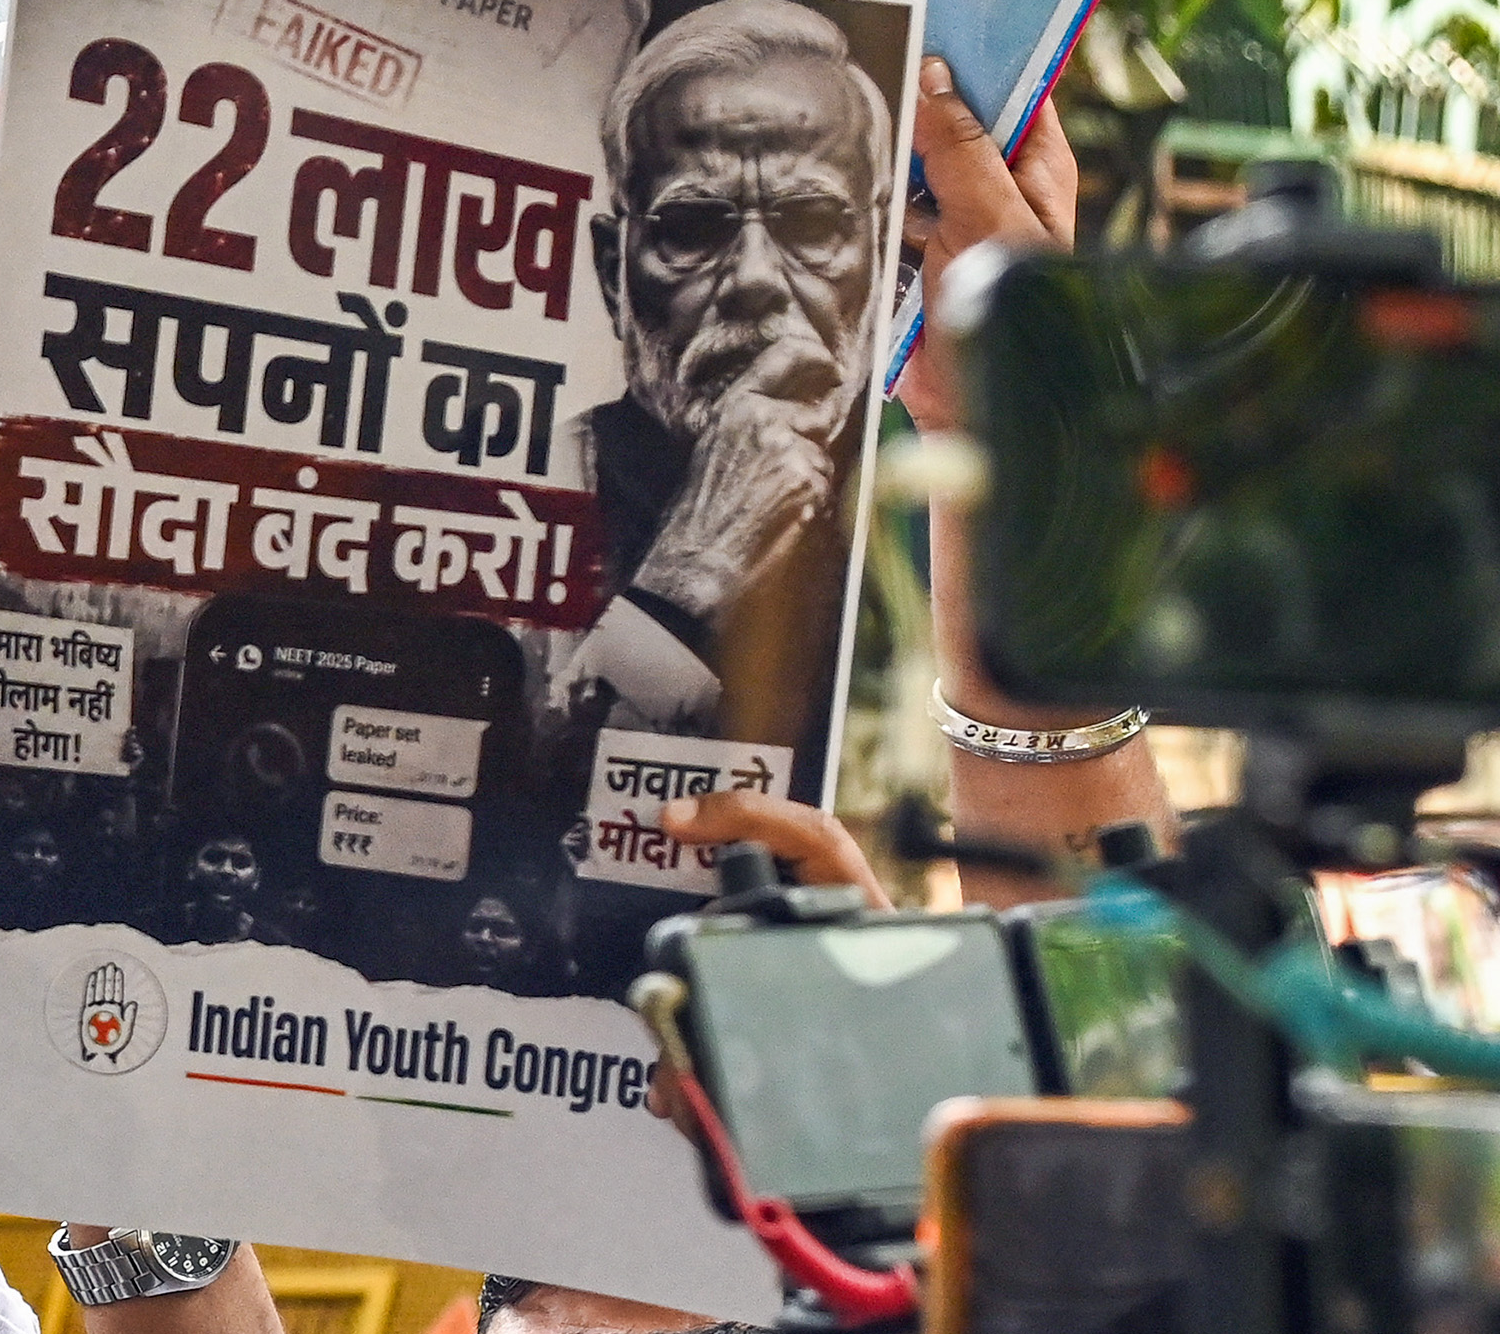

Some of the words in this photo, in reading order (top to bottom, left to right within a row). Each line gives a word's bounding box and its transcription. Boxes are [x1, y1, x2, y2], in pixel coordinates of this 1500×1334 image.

[50, 36, 271, 271] 22
[287, 107, 594, 322] लाख
[41, 271, 409, 453] सपनों
[421, 339, 566, 476] का
[19, 432, 240, 576] सौदा
[250, 464, 382, 593] बंद
[392, 489, 574, 606] करो!
[274, 646, 314, 665] NEET
[316, 651, 353, 669] 2025
[355, 655, 397, 676] Paper
[67, 682, 115, 721] नहीं
[14, 720, 82, 764] होगा!
[344, 717, 393, 742] Paper
[396, 726, 421, 743] set
[964, 724, 1067, 750] METRO
[340, 745, 397, 769] leaked
[607, 756, 722, 800] जवाब
[334, 803, 382, 826] Price:
[188, 990, 328, 1067] Indian
[345, 1009, 470, 1085] Youth
